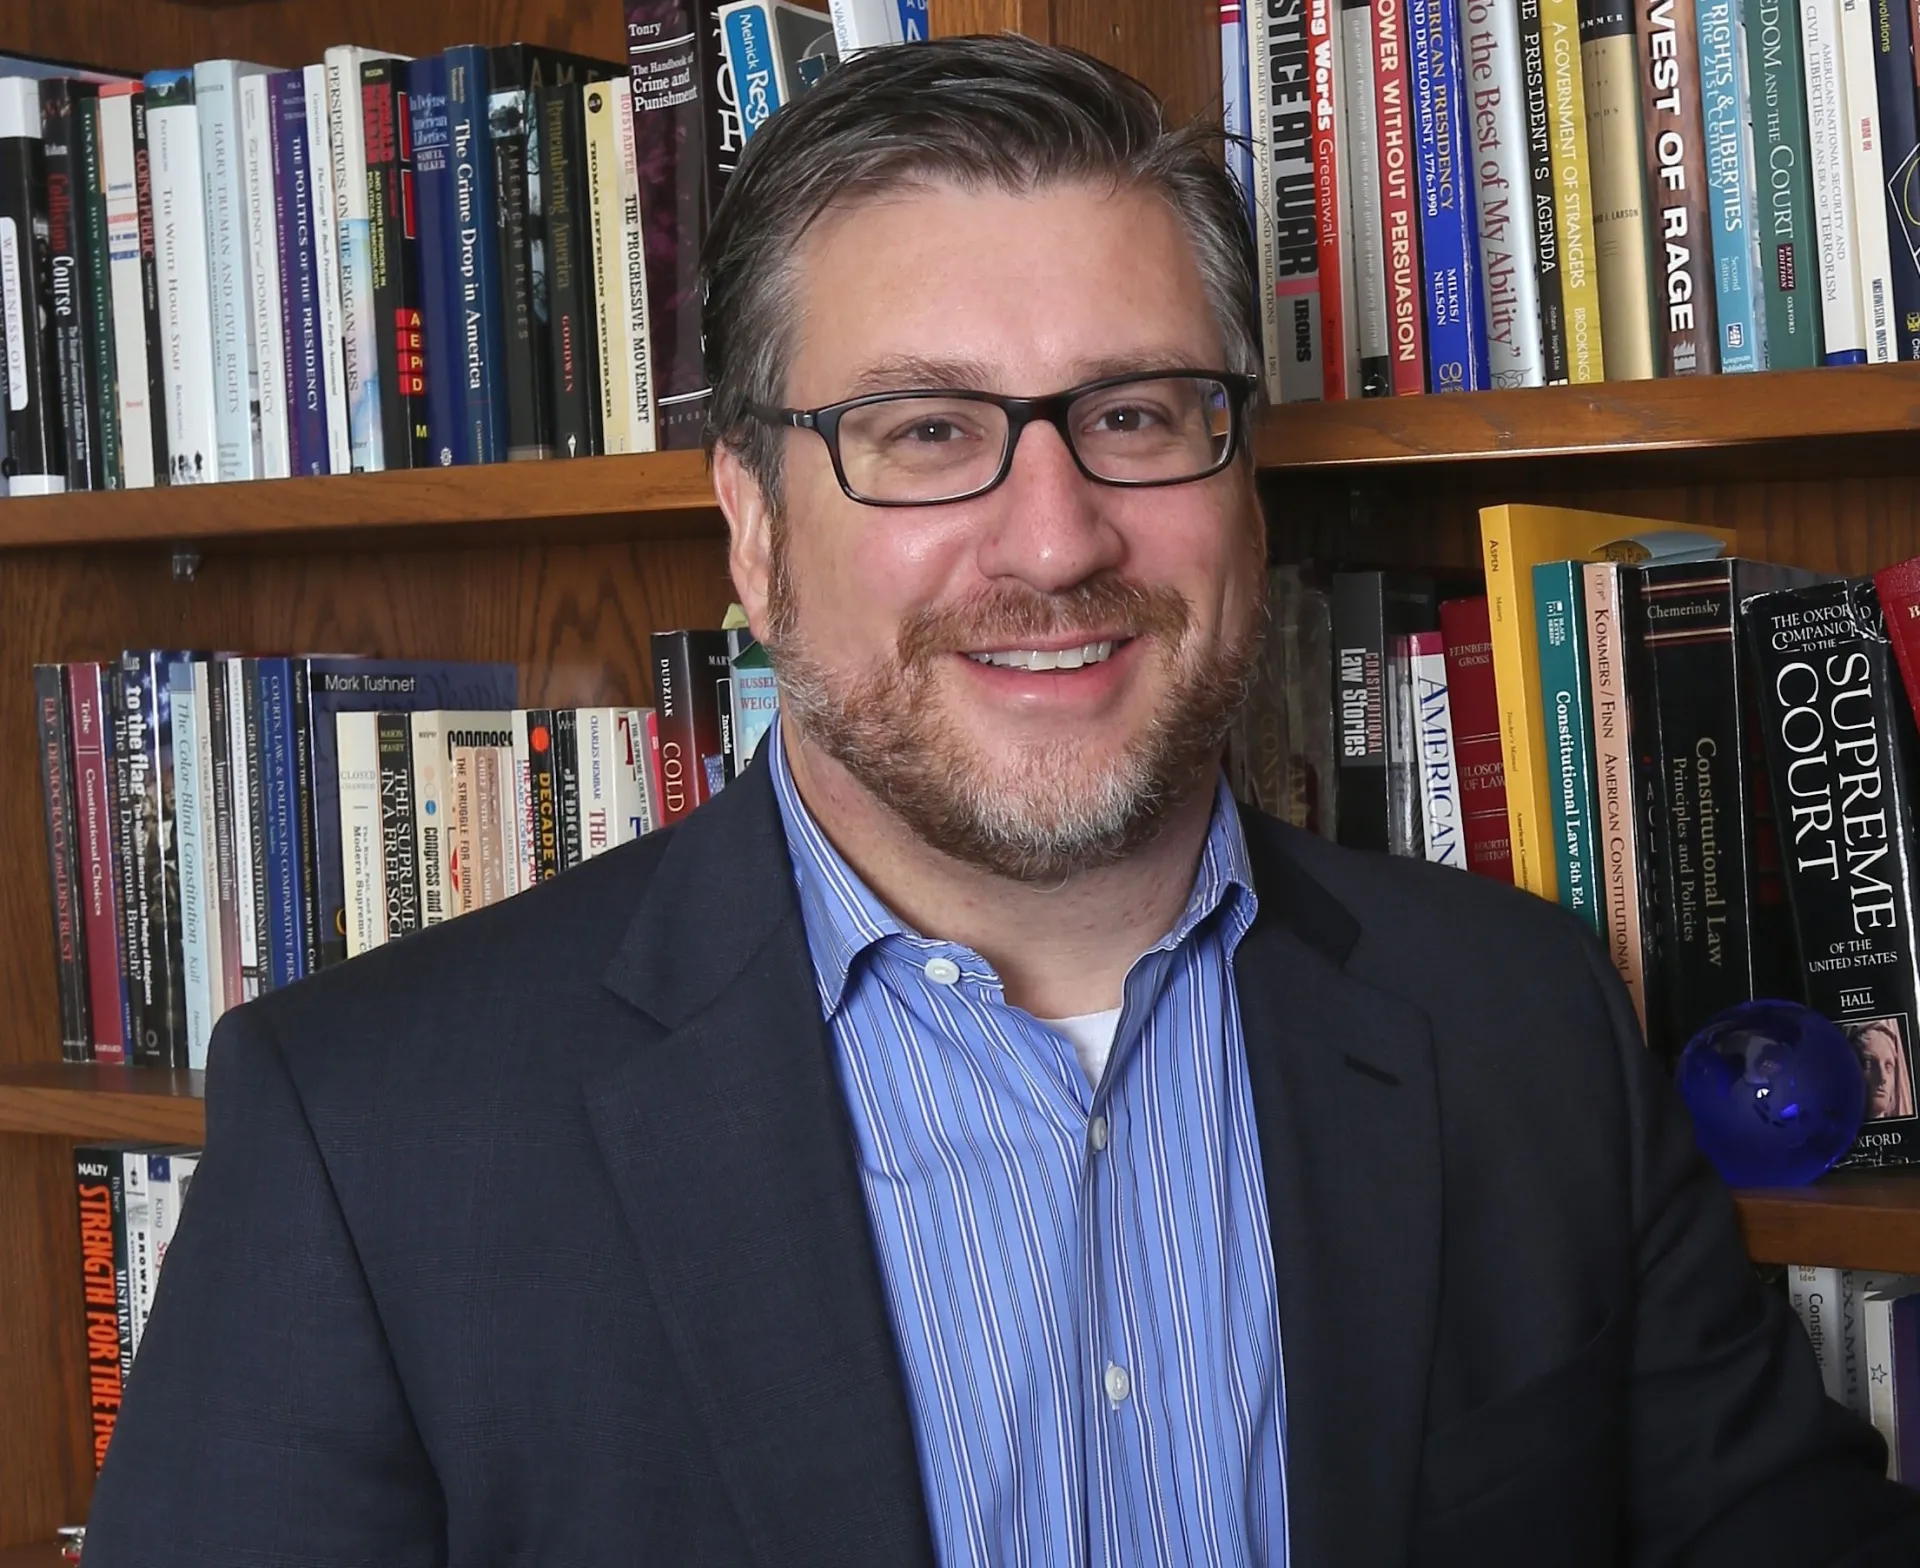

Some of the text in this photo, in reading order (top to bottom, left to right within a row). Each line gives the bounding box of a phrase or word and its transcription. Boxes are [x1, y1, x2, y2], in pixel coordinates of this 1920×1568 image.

[628, 22, 661, 37] Tonry
[632, 51, 695, 76] The of
[739, 13, 760, 69] Melnick
[632, 67, 691, 94] Crime and
[634, 86, 699, 113] Punishment
[1314, 40, 1334, 131] Words
[1711, 2, 1743, 232] RIGHTS & LIBERTIES
[454, 119, 471, 158] The
[1415, 30, 1438, 217] DEVELOPMENT, 1776-1990
[1433, 84, 1454, 210] PRESIDENCY
[1470, 31, 1511, 243] the Best of My
[1525, 32, 1556, 274] PRESIDENT'S AGENDA
[1707, 108, 1724, 189] Century
[1764, 72, 1795, 238] AND THE COURT
[1806, 6, 1837, 302] CIVIL LIBERTIES IN AN ERA TERRORISM
[1822, 43, 1846, 260] AMERICAN NATIONAL SECURITY AND
[457, 164, 474, 222] Crime
[590, 140, 600, 205] THOMAS
[1256, 34, 1276, 325] SUBVERSIVE AND PUBLICATIONS
[1552, 22, 1590, 381] A GOVERNMENT OF STRANGERS BROOKINGS
[47, 172, 74, 316] Collision Course
[329, 65, 359, 391] PERSPECTIVES ON THE REAGAN YEARS
[460, 227, 477, 277] Drop
[507, 144, 528, 340] AMERICAN PLACES
[1383, 79, 1416, 361] WITHOUT PERSUASION
[1657, 132, 1695, 332] OF RAGE
[162, 188, 181, 372] THE WHITE HOUSE STAFF
[214, 123, 239, 414] HARRY TRUMAN AND CIVIL RIGHTS
[292, 135, 318, 412] THE POLITICS OF THE PRESIDENCY
[464, 283, 479, 300] in
[1434, 271, 1447, 326] NELSON
[1446, 268, 1460, 323] MILKIS/
[1720, 257, 1730, 293] Edition
[1730, 255, 1741, 291] Second
[1778, 248, 1787, 288] EDITION
[1785, 245, 1794, 288] SEVENTH
[256, 274, 273, 416] DOMESTIC POLICY
[624, 194, 650, 424] THE PROGRESSIVE MOVEMENT
[1786, 296, 1796, 334] OXFORD
[10, 350, 21, 372] OF
[465, 308, 484, 389] America
[561, 315, 573, 393] GOODWIN
[1489, 540, 1500, 573] ASPEN
[1647, 600, 1720, 620] Chemerinsky
[1771, 612, 1800, 629] THE
[1802, 638, 1837, 653] TO THE
[325, 674, 417, 692] Mark Tushnet
[1458, 655, 1489, 667] GROSS
[1594, 608, 1611, 687] KOMMERS
[127, 713, 149, 797] the flag
[660, 658, 685, 812] DUDZIAK COLD
[721, 714, 731, 754] Inroads
[1342, 688, 1370, 757] Stories
[1601, 701, 1616, 738] FINN
[117, 757, 131, 807] Least
[590, 714, 602, 801] CHARLES REMBAR
[633, 740, 646, 803] SUPREME COURT
[1776, 662, 1840, 881] COURT
[1826, 653, 1897, 935] SUPREME
[80, 698, 103, 917] Tribe Constitutional Choices
[478, 756, 489, 833] CHIEF JUSTICE
[524, 787, 536, 852] JONES &
[539, 772, 555, 861] DECADE
[1556, 691, 1584, 909] Constitutional Law 5th Ed.
[280, 841, 289, 857] IN
[384, 827, 399, 883] FREE
[457, 757, 473, 911] THE STRUGGLE FOR JUDICIAL
[1672, 756, 1697, 942] Principles and Policies
[1695, 737, 1727, 966] Constitutional Law
[354, 825, 366, 938] Modern Supreme
[396, 821, 416, 929] SUPREME
[188, 956, 200, 984] Kull
[259, 945, 269, 974] LAW
[1809, 951, 1898, 973] UNITED STATES
[1829, 938, 1873, 955] OF THE
[1840, 992, 1875, 1008] HALL
[78, 1162, 110, 1178] NALTY
[155, 1198, 165, 1229] King
[78, 1184, 121, 1361] STRENGTH FOR
[138, 1231, 148, 1295] BROWN
